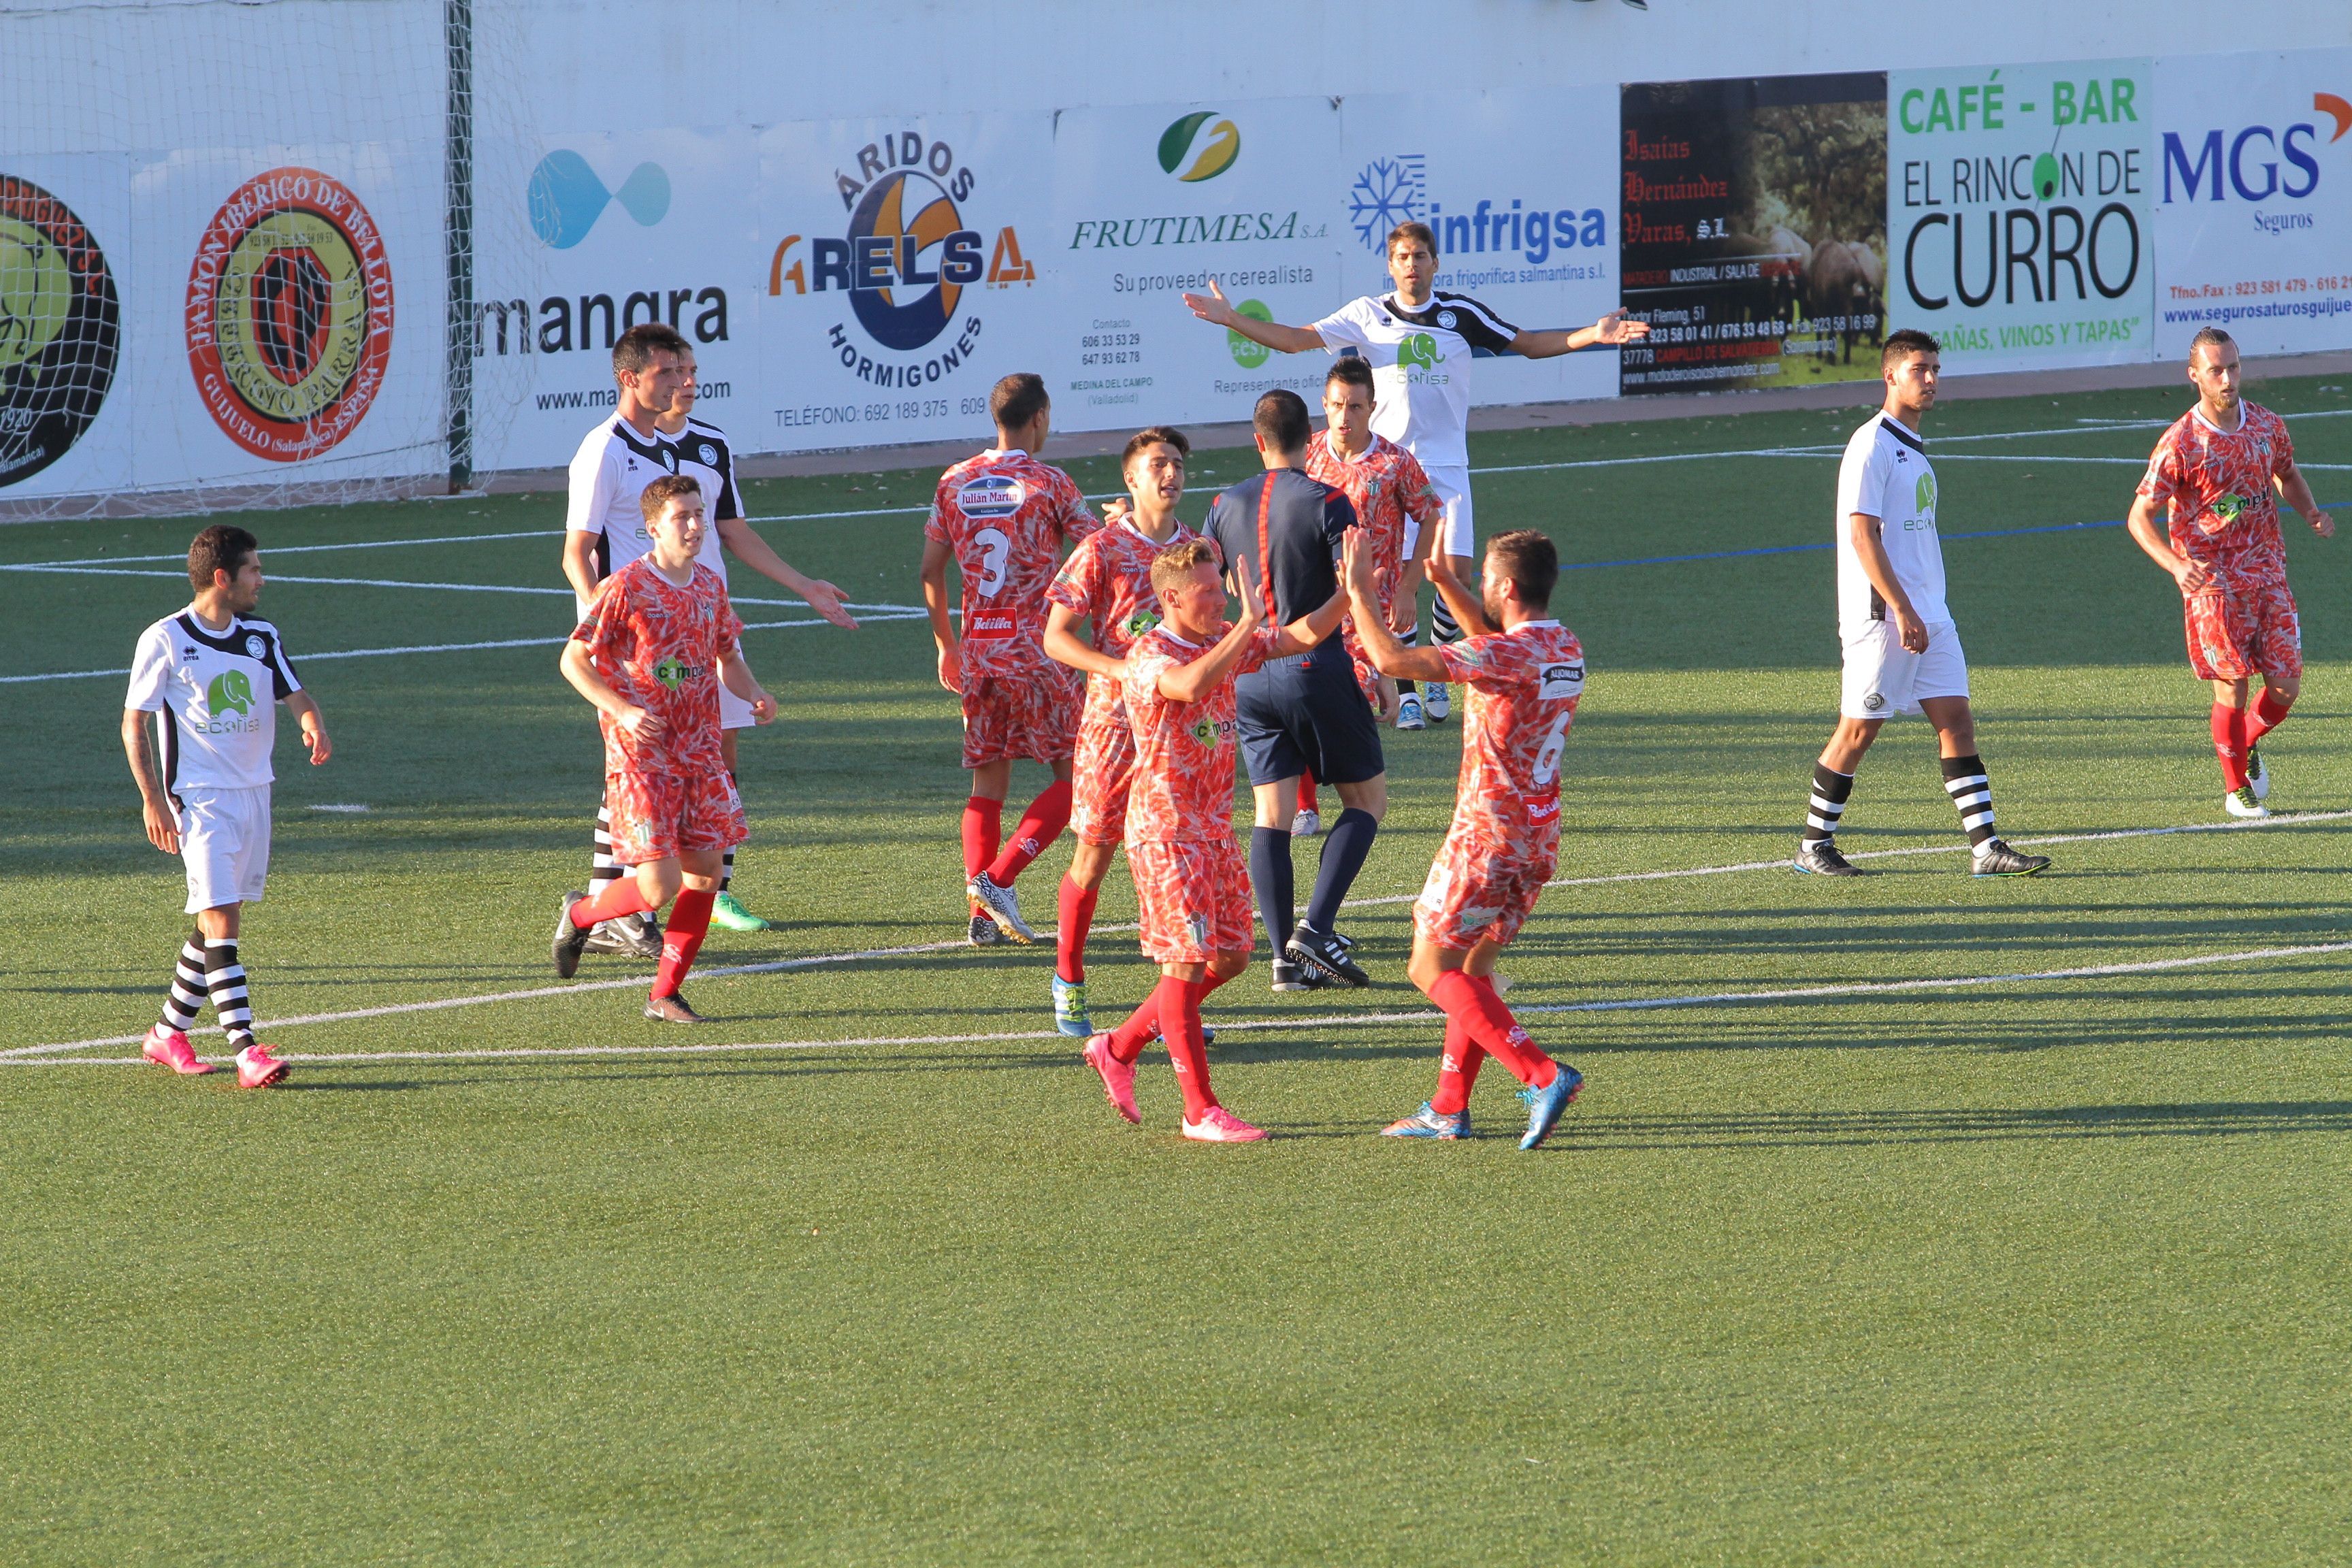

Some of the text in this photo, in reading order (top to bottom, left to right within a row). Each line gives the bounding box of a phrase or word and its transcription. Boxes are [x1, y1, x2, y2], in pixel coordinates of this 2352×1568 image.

[1899, 69, 2004, 133] CAFÉ
[2053, 78, 2138, 125] BAR
[834, 131, 974, 212] ÁRIDOS
[1905, 161, 1941, 206] EL
[2097, 149, 2140, 195] DE
[2161, 122, 2319, 203] MGS
[314, 181, 349, 216] DE
[1624, 171, 1729, 206] Hernández
[1068, 211, 1328, 249] FRUTIMESA S.A.
[1431, 199, 1606, 264] infrigsa
[1624, 212, 1730, 245] Varas, S.L.
[2254, 210, 2314, 236] Seguros
[1670, 265, 1718, 282] INDUSTRIAL
[1725, 264, 1746, 279] SALA
[1748, 263, 1760, 278] DE
[1905, 202, 2140, 310] CURRO
[1113, 265, 1313, 295] Su proveedor cerealista
[1457, 267, 1516, 289] frigorífica
[1520, 265, 1585, 282] salmantina
[2236, 281, 2257, 295] 923
[2261, 280, 2281, 294] 581
[2285, 278, 2307, 292] 479
[2317, 277, 2338, 291] 616
[472, 286, 730, 357] mangra
[1649, 328, 1668, 344] 923
[1671, 327, 1683, 342] 58
[1685, 326, 1697, 341] 01
[1700, 325, 1712, 340] 41
[1721, 323, 1740, 338] 676
[1742, 322, 1755, 338] 33
[1757, 321, 1769, 336] 48
[1772, 321, 1784, 336] 68
[1813, 317, 1831, 332] 923
[1833, 316, 1846, 331] 58
[1998, 324, 2055, 348] VINOS
[2059, 323, 2070, 345] Y
[828, 316, 981, 388] HORMIGONES
[1082, 333, 1140, 347] 606 33 53 29
[1656, 348, 1701, 363] CAMPILLO
[1705, 345, 1716, 360] DE
[301, 311, 363, 406] PARRA
[1082, 351, 1140, 365] 647 93 62 78
[1071, 376, 1153, 390] MEDINA DEL CAMPO
[1214, 376, 1301, 393] Representante
[204, 373, 270, 448] GUIJUELO
[774, 397, 985, 427] TELÉFONO: 692 189 375 609
[962, 493, 987, 505] Julián
[974, 527, 1010, 598] 3
[1533, 710, 1569, 785] 6
